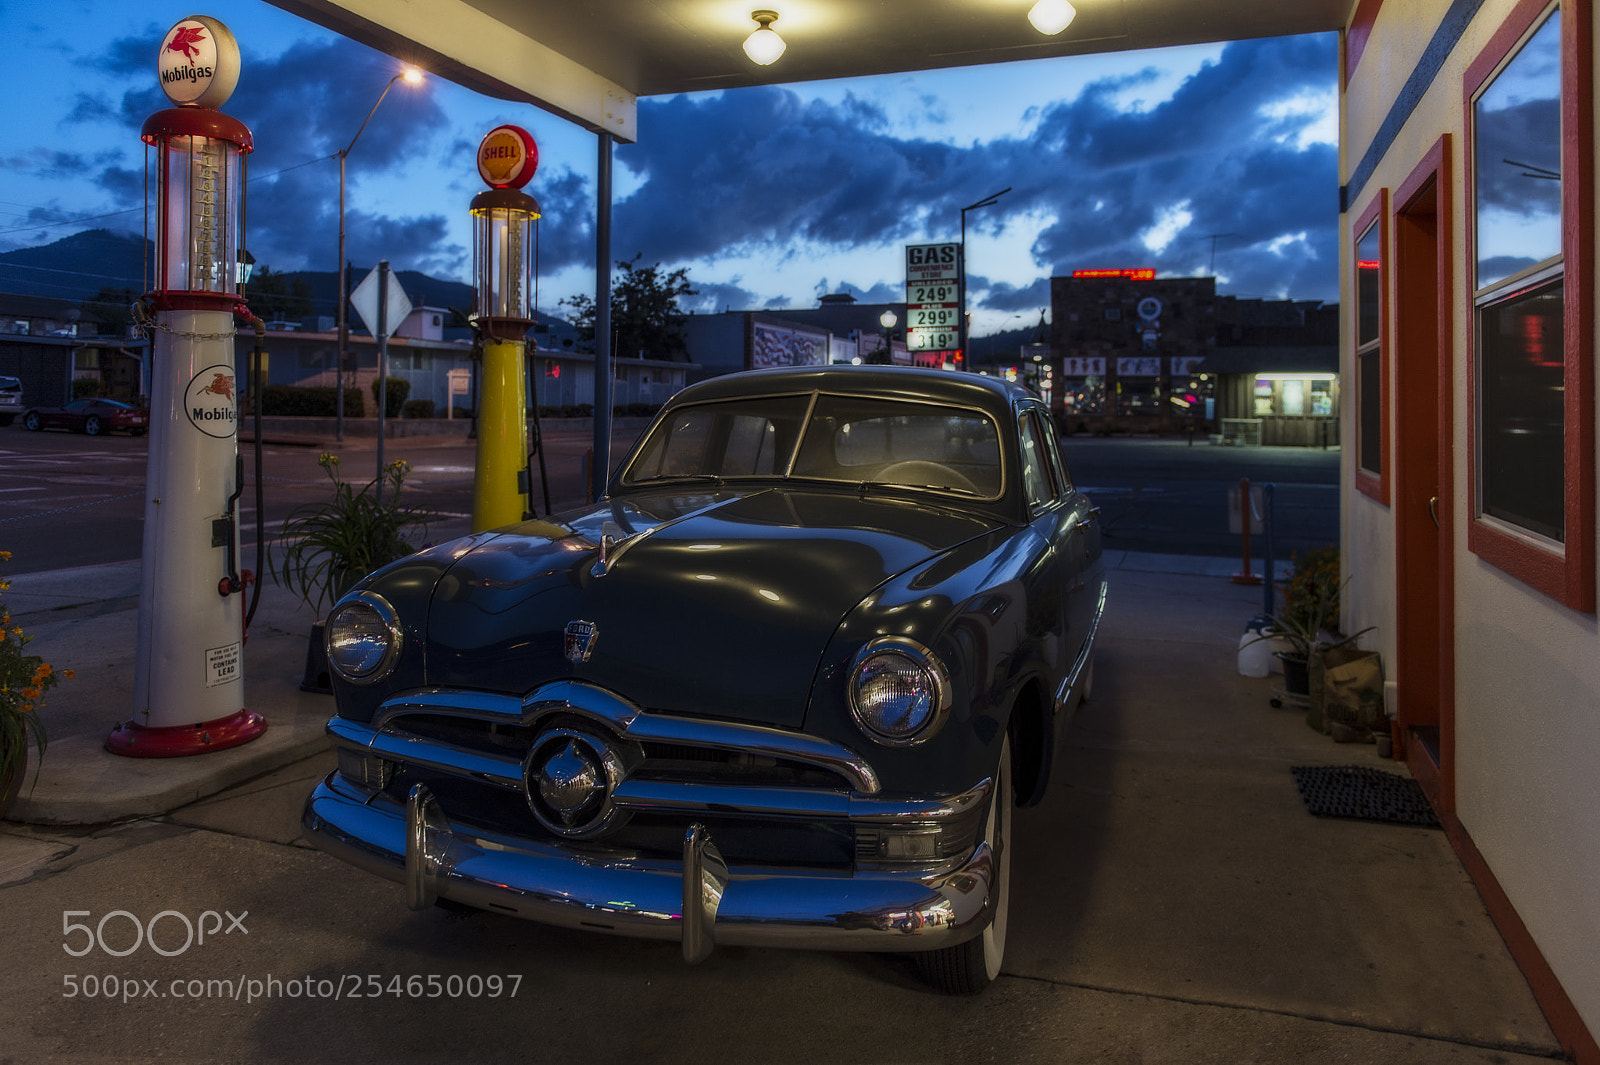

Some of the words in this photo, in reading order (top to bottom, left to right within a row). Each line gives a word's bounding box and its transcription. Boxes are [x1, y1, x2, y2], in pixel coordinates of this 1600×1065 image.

[162, 65, 212, 84] Mobilgas
[484, 146, 517, 160] SHELL
[909, 246, 955, 265] GAS
[568, 624, 591, 634] FORD
[213, 658, 238, 669] CONTAINS
[218, 666, 235, 677] LEAD
